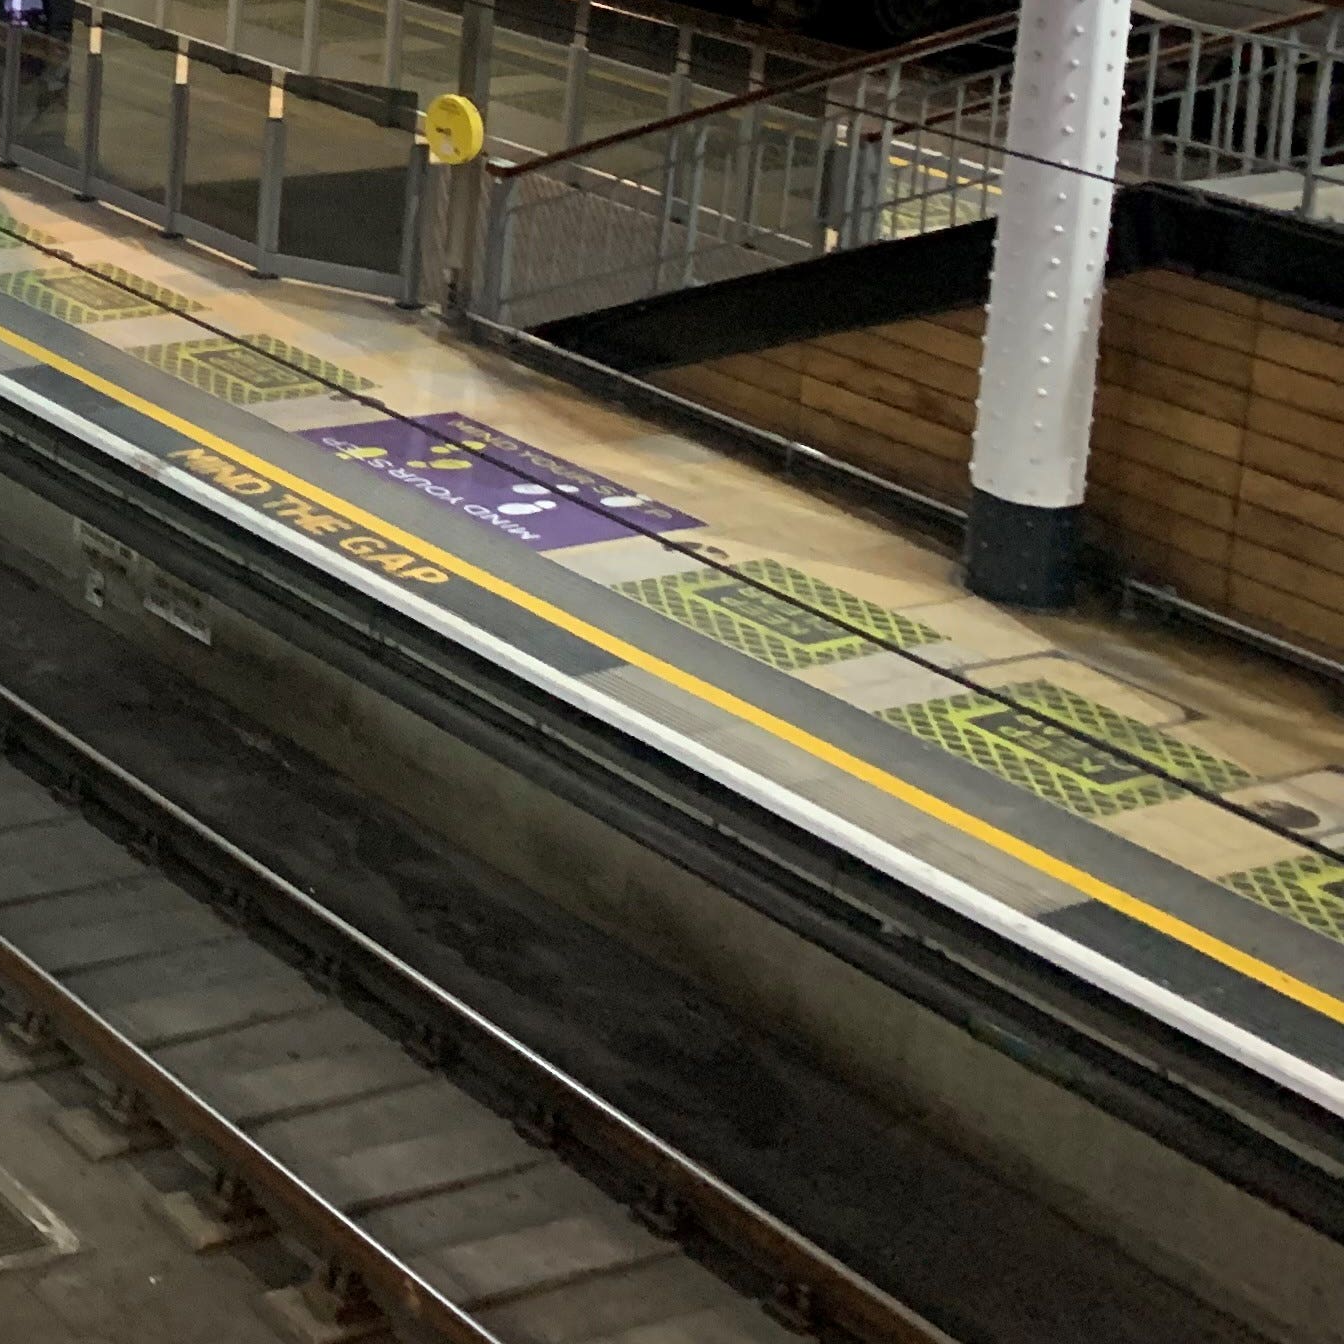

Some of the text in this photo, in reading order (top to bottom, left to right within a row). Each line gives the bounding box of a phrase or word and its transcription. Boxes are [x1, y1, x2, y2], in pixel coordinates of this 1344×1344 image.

[387, 466, 465, 505] YOUR
[262, 493, 353, 536] THE
[339, 536, 450, 584] GAP
[463, 503, 542, 541] MIND
